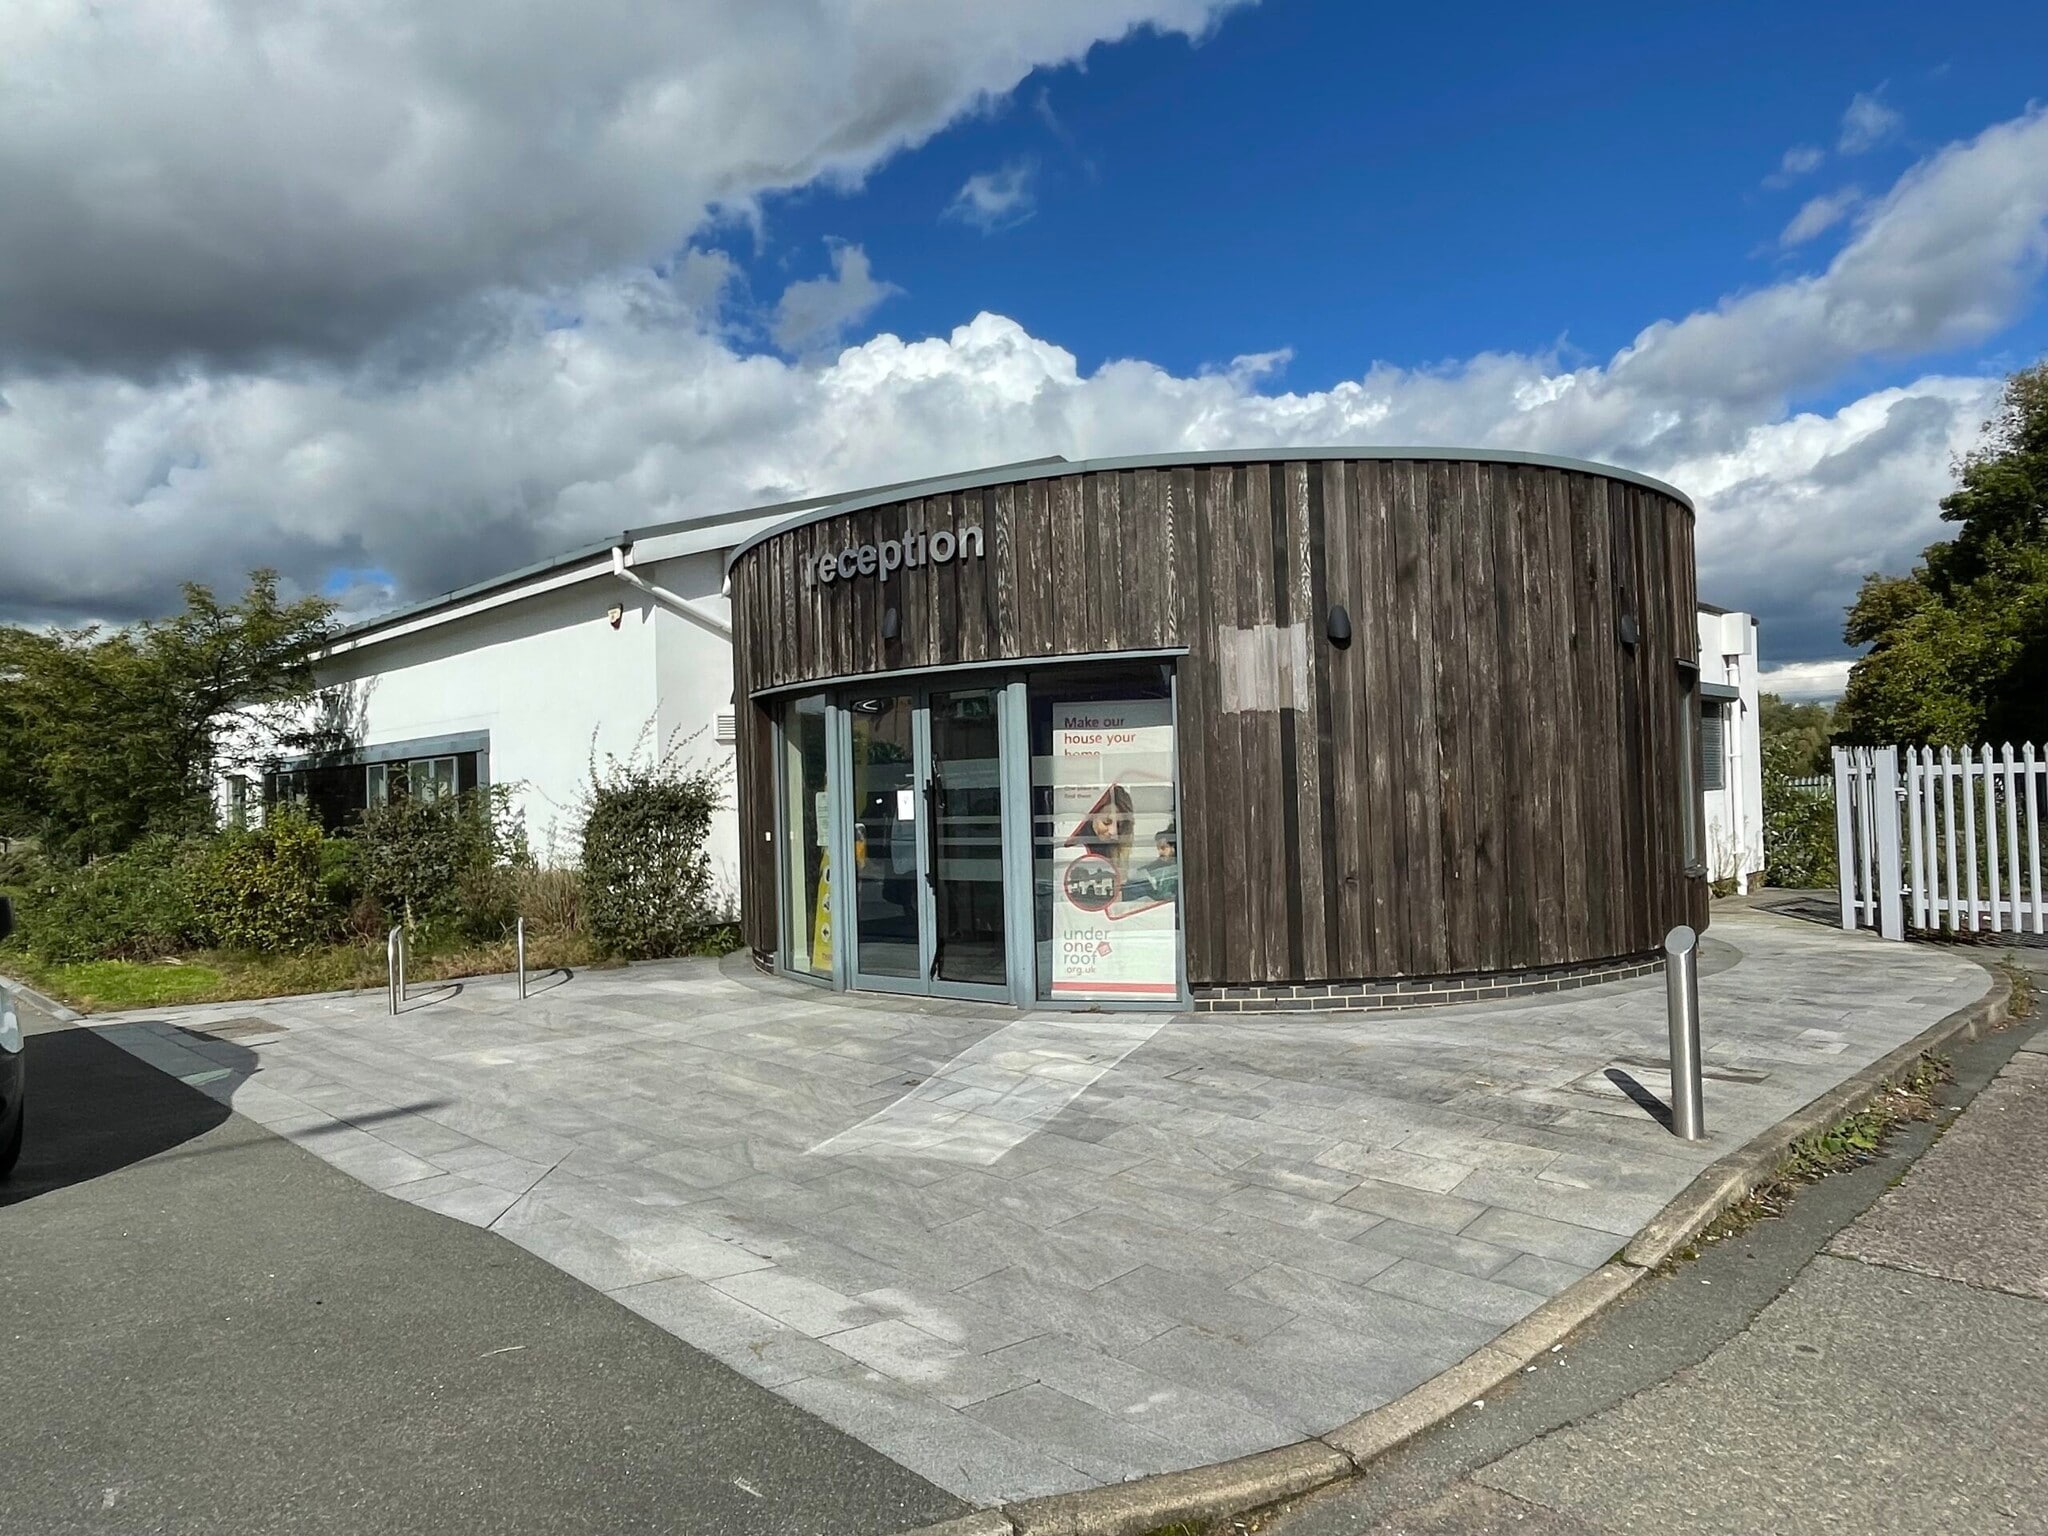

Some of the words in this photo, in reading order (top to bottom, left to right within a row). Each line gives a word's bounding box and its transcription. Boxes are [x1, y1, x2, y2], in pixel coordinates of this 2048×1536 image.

[809, 526, 984, 586] reception
[1064, 716, 1099, 728] Make
[1103, 718, 1125, 727] our
[1064, 733, 1102, 744] house
[1107, 733, 1136, 746] your
[1064, 927, 1110, 940] under
[1064, 942, 1093, 952] one
[1064, 951, 1097, 964] roof
